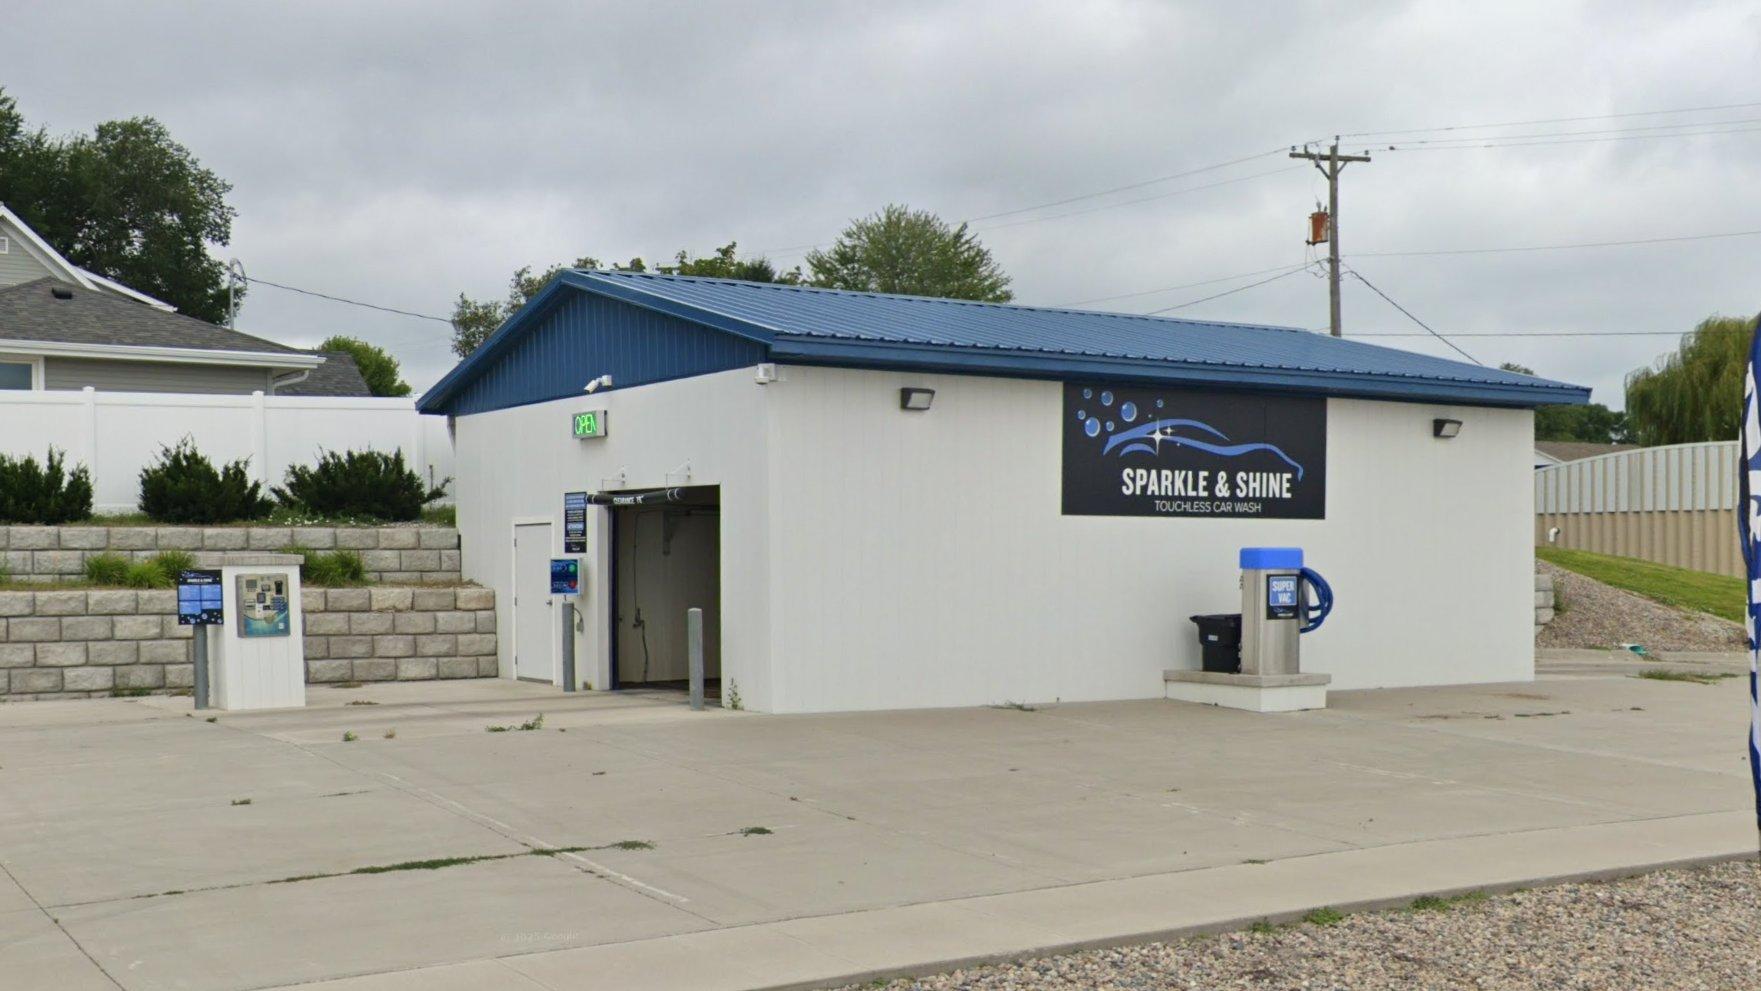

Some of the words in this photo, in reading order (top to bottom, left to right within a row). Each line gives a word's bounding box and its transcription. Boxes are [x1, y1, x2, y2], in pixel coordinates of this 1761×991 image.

[575, 414, 595, 434] OPEN
[1122, 468, 1209, 497] SPARKLE
[1215, 471, 1230, 498] &
[1236, 471, 1292, 498] SHINE
[1155, 500, 1211, 513] TOUCHLESS
[1213, 501, 1233, 513] CAR
[1234, 502, 1261, 513] WASH
[1272, 580, 1294, 591] SUPER
[1278, 592, 1292, 603] VAC
